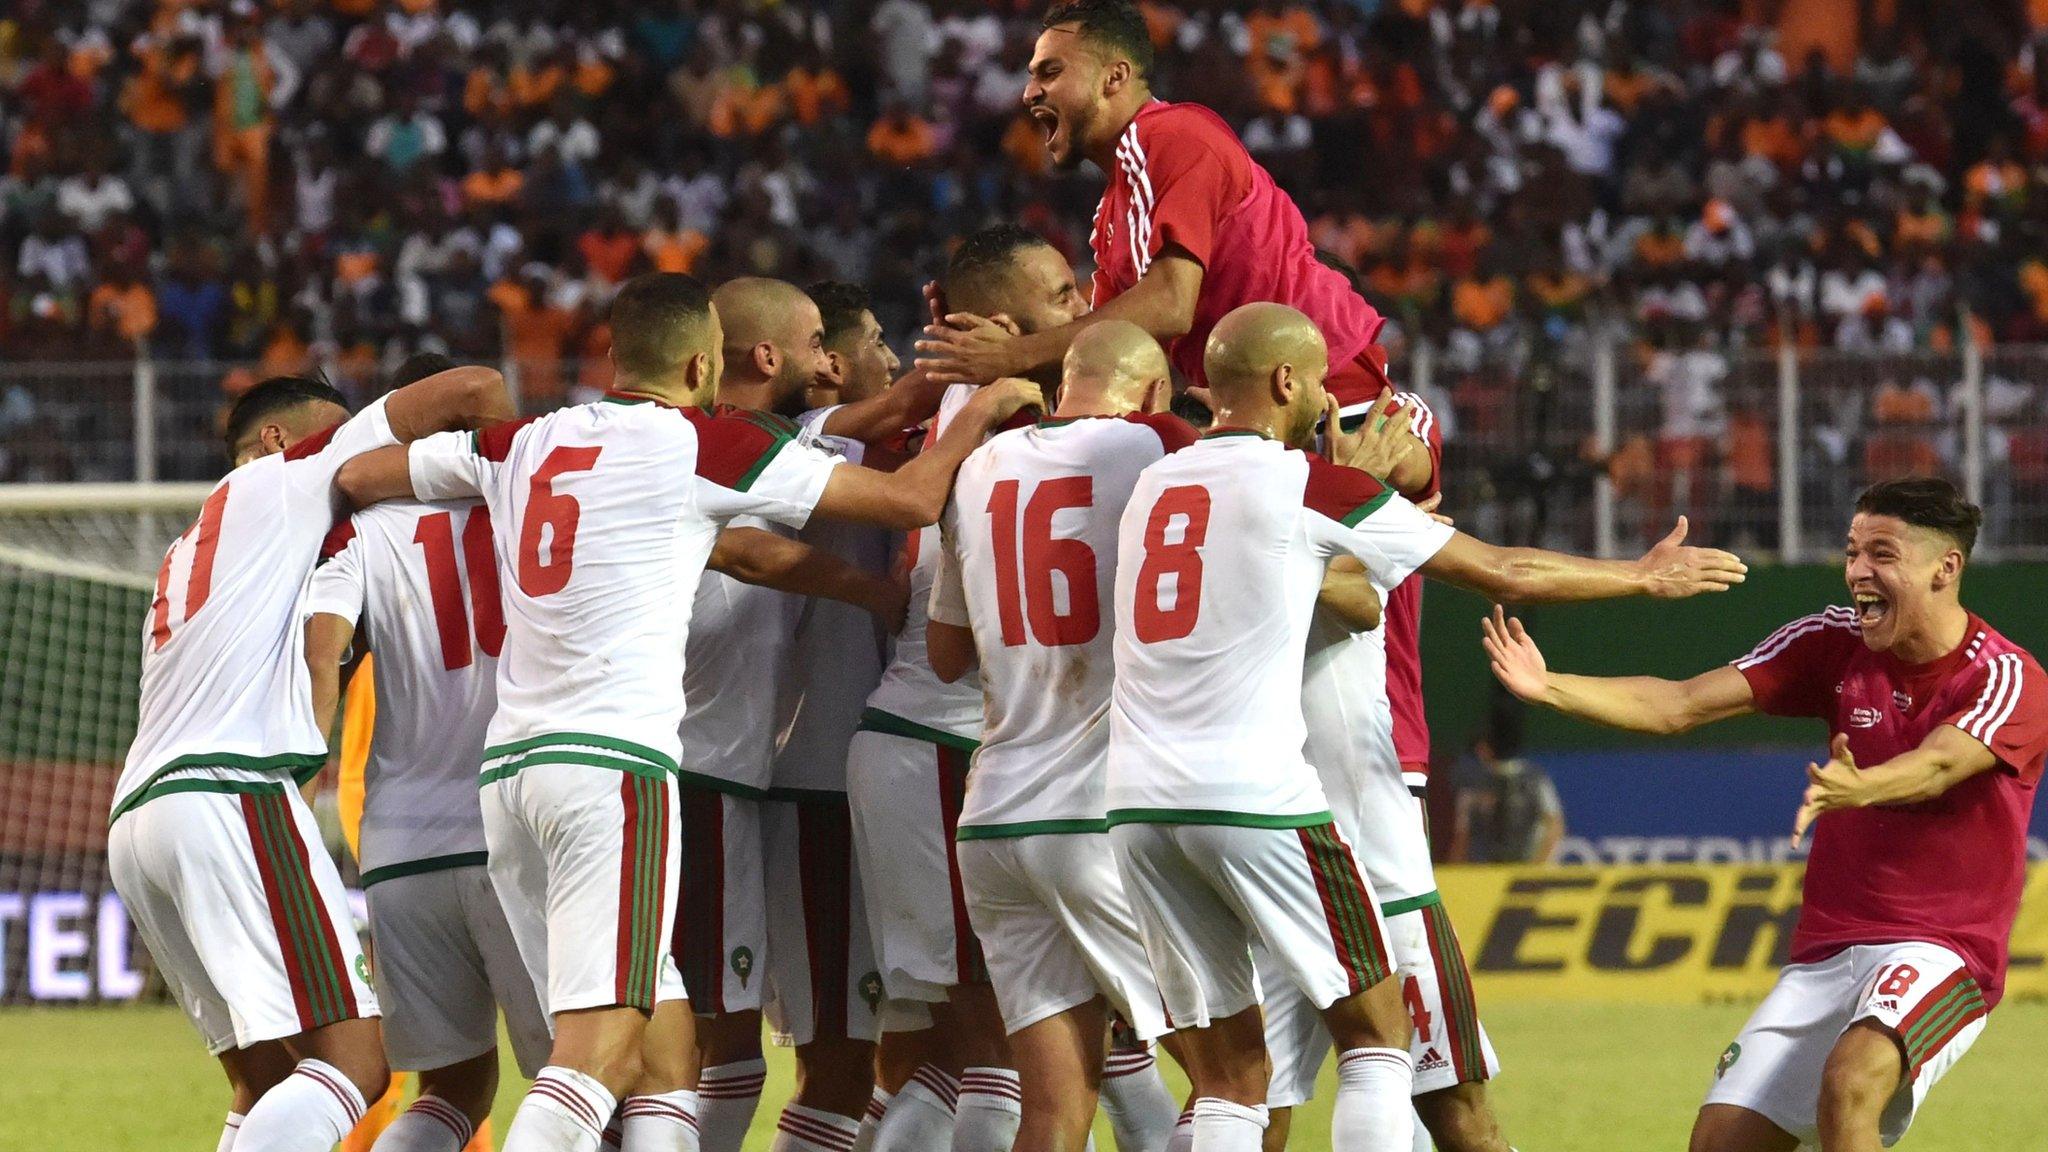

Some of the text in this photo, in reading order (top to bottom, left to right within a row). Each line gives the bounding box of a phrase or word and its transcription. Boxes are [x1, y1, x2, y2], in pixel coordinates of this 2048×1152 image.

[518, 446, 603, 598] 6
[986, 475, 1099, 647] 16
[1134, 484, 1211, 645] 8
[1867, 963, 1920, 998] 18
